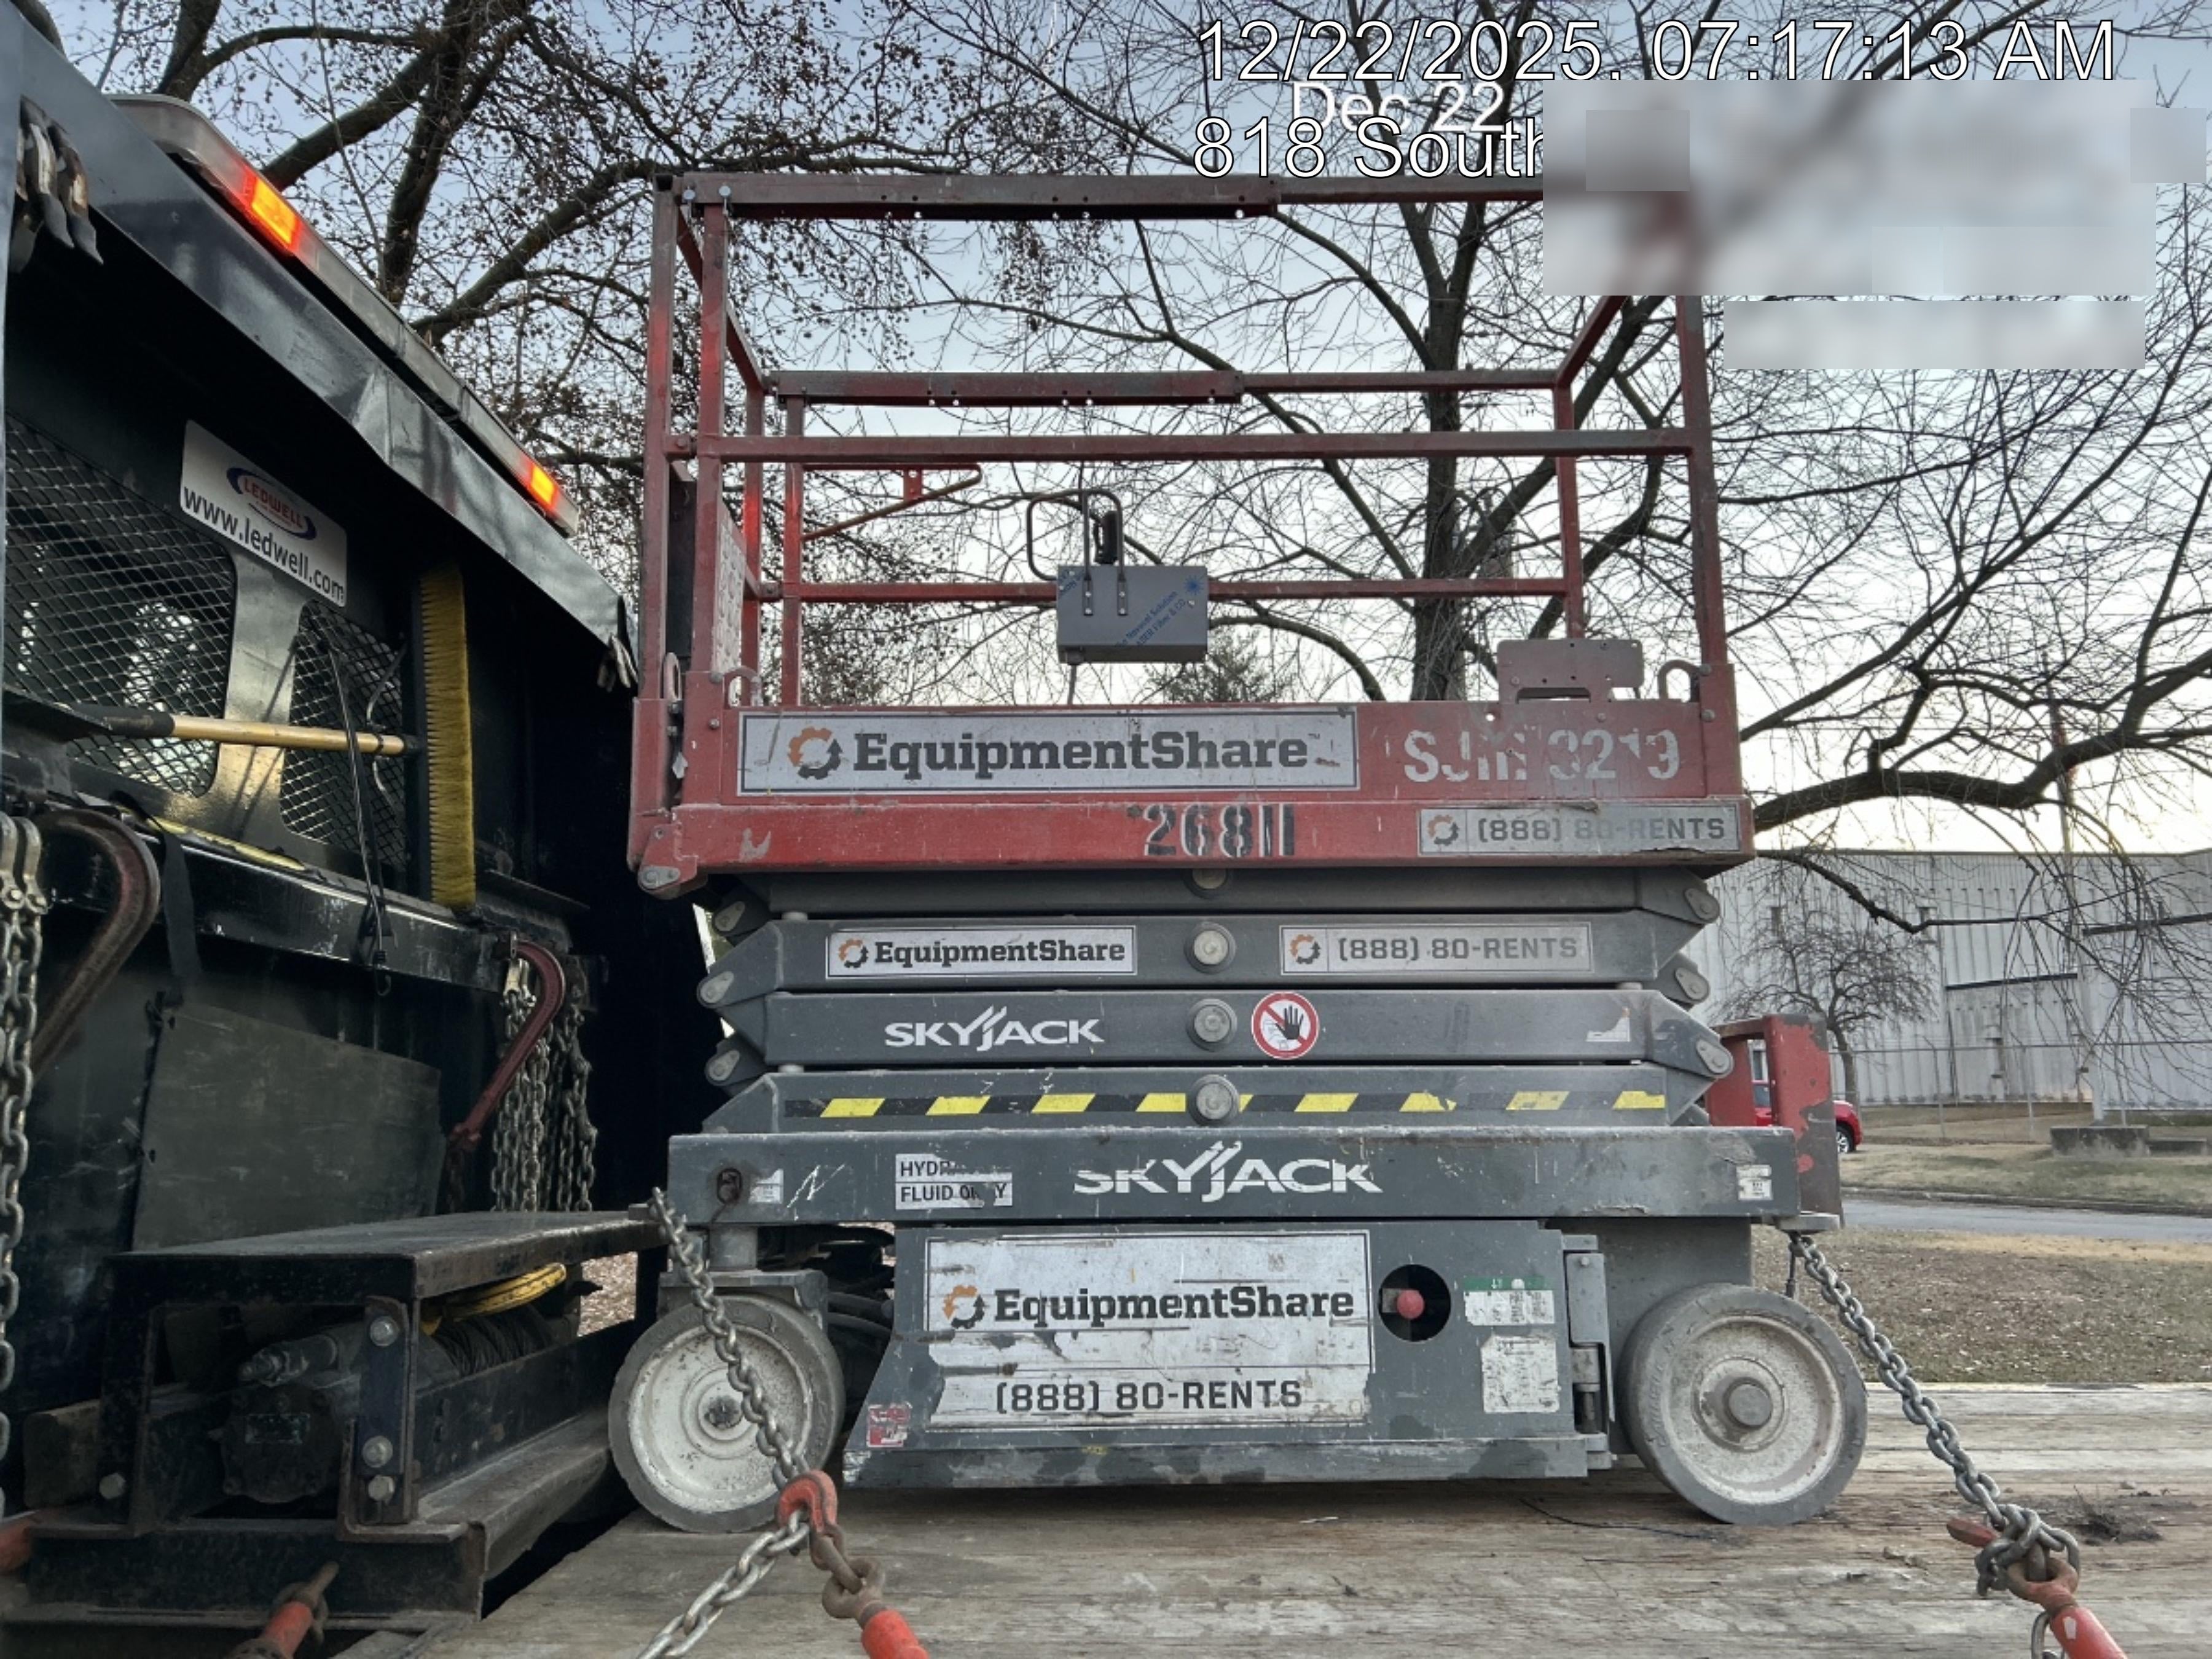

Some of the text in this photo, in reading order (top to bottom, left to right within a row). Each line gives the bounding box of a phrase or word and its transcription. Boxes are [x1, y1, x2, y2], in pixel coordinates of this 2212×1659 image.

[243, 477, 303, 529] LEDWELL
[184, 486, 345, 605] www.ledwell.com
[853, 731, 1308, 780] EquipmentShare
[1478, 817, 1725, 842] (888) 80-RENTS
[875, 939, 1125, 968] EquipmentShare
[1338, 936, 1577, 962] (888) 80-RENTS
[884, 1005, 1105, 1051] SKYJACK
[1073, 1140, 1383, 1202] SKYJACK
[901, 1184, 953, 1202] FLUID
[994, 1286, 1354, 1327] EquipmentShare
[996, 1379, 1303, 1413] (888) 80-RENTS
